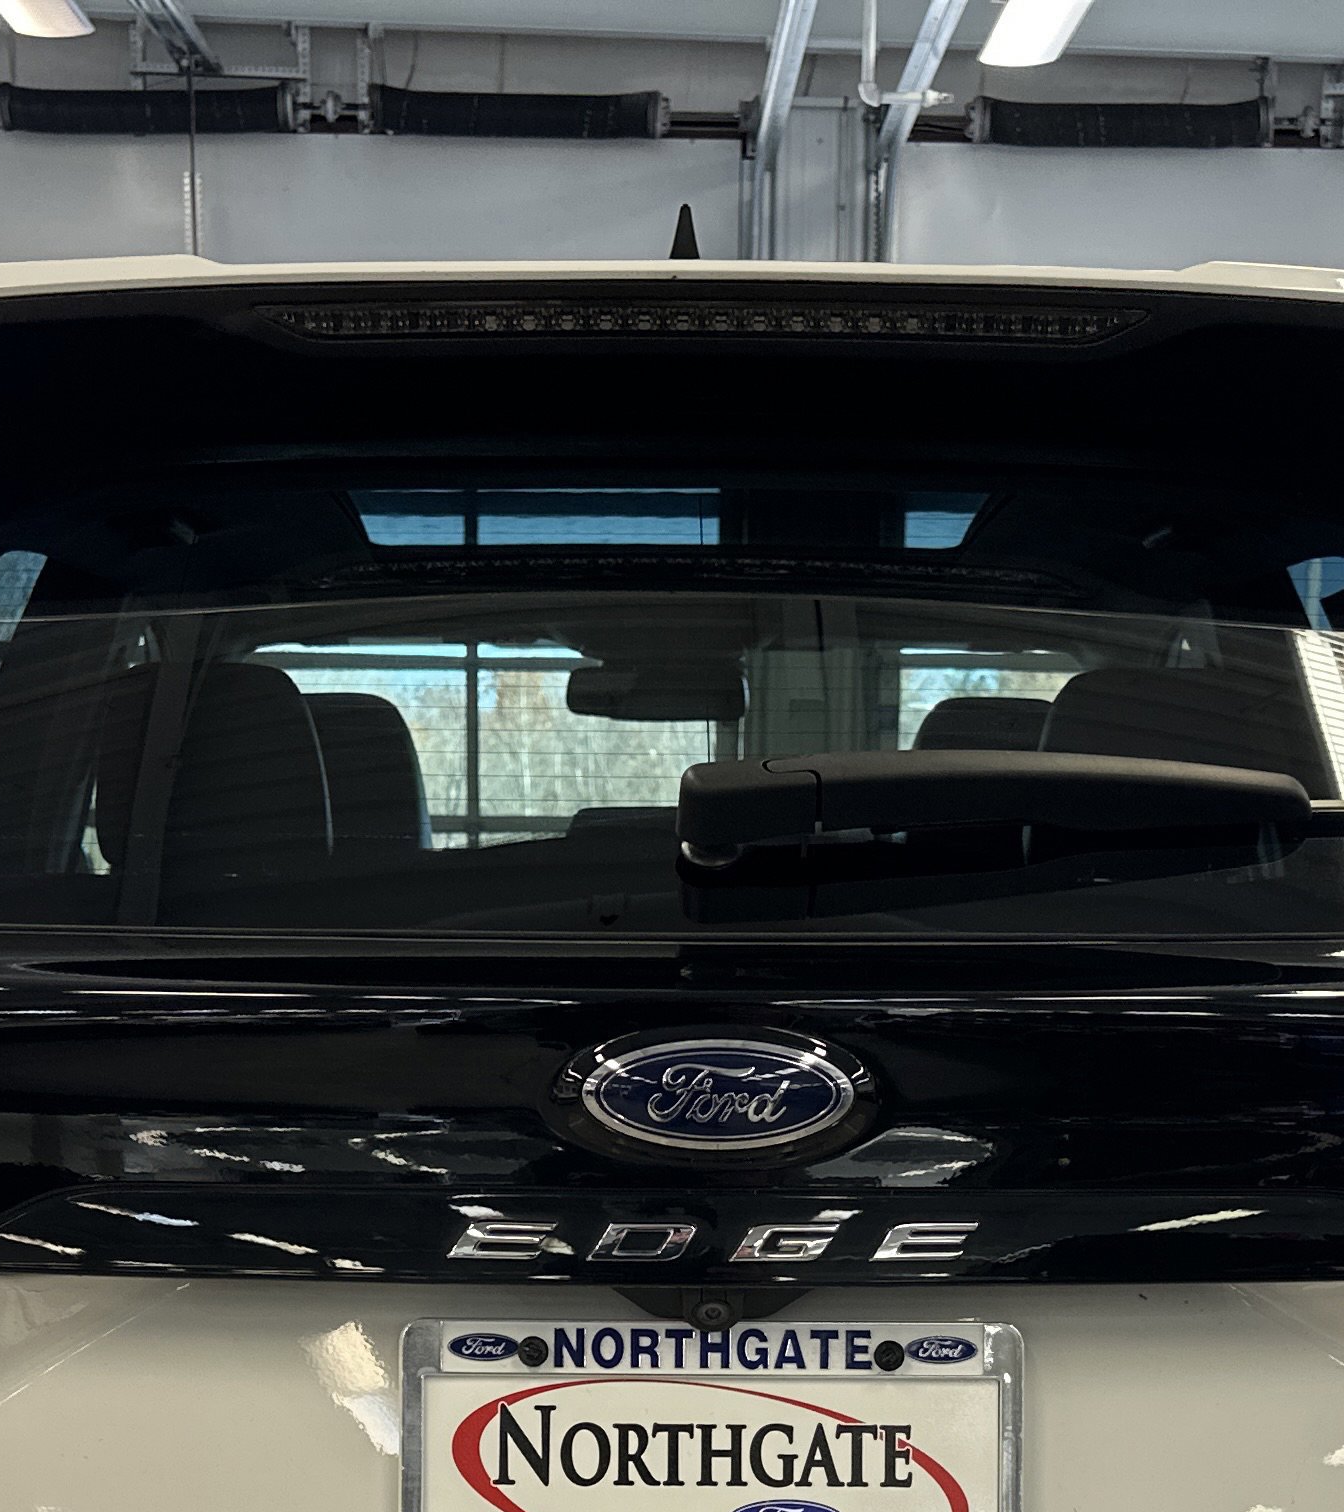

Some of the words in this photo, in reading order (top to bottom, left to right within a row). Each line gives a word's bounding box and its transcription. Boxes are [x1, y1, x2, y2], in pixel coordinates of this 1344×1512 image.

[646, 1063, 788, 1124] Ford
[447, 1221, 980, 1262] EDGE
[462, 1337, 506, 1356] Ford
[553, 1327, 873, 1370] NORTHGATE
[917, 1340, 963, 1358] Ford
